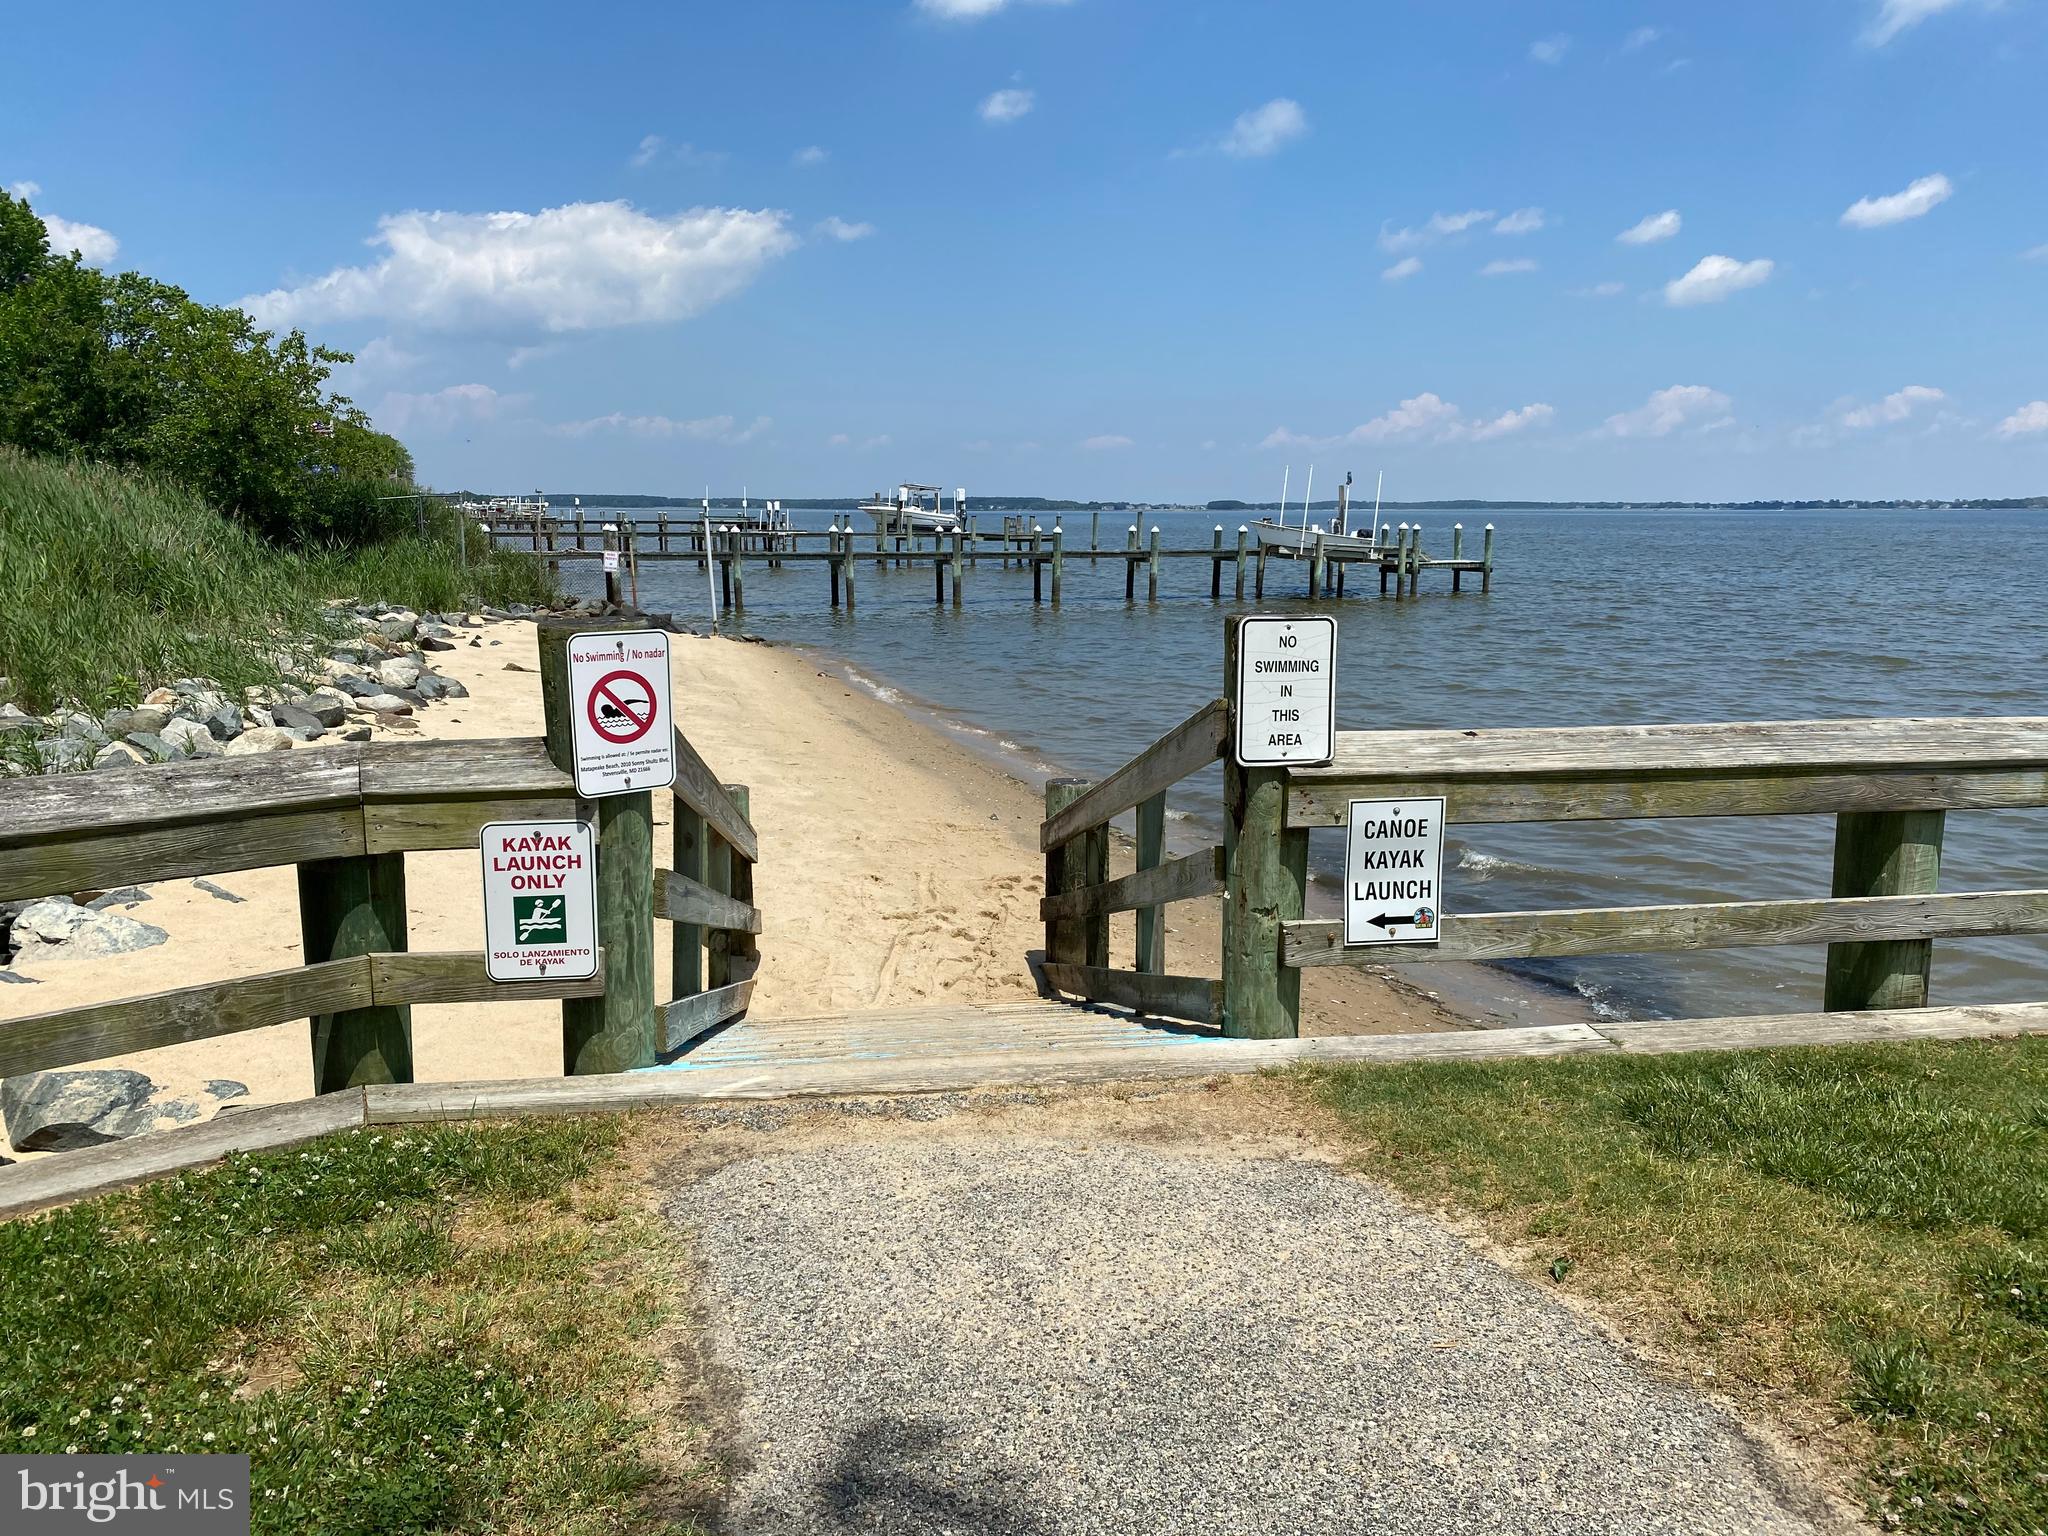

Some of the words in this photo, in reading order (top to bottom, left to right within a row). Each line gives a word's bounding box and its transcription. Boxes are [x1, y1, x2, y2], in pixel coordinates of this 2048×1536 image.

[1279, 636, 1297, 648] NO
[573, 653, 584, 663] No
[586, 650, 625, 663] Swimming
[632, 649, 643, 659] No
[644, 648, 665, 658] nadar
[1255, 660, 1319, 673] SWIMMING
[1280, 685, 1292, 697] IN
[1272, 709, 1300, 721] THIS
[1268, 733, 1302, 746] AREA
[581, 754, 601, 762] Swimming
[1364, 819, 1429, 839] CANOE
[502, 836, 572, 853] KAYAK
[493, 854, 582, 872] LAUNCH
[1364, 850, 1425, 869] KAYAK
[511, 874, 566, 890] ONLY
[1354, 880, 1431, 901] LAUNCH
[494, 951, 520, 959] SOLO
[522, 948, 590, 958] LANZAMIENTO
[520, 958, 532, 966] DE
[535, 957, 565, 966] KAYAK
